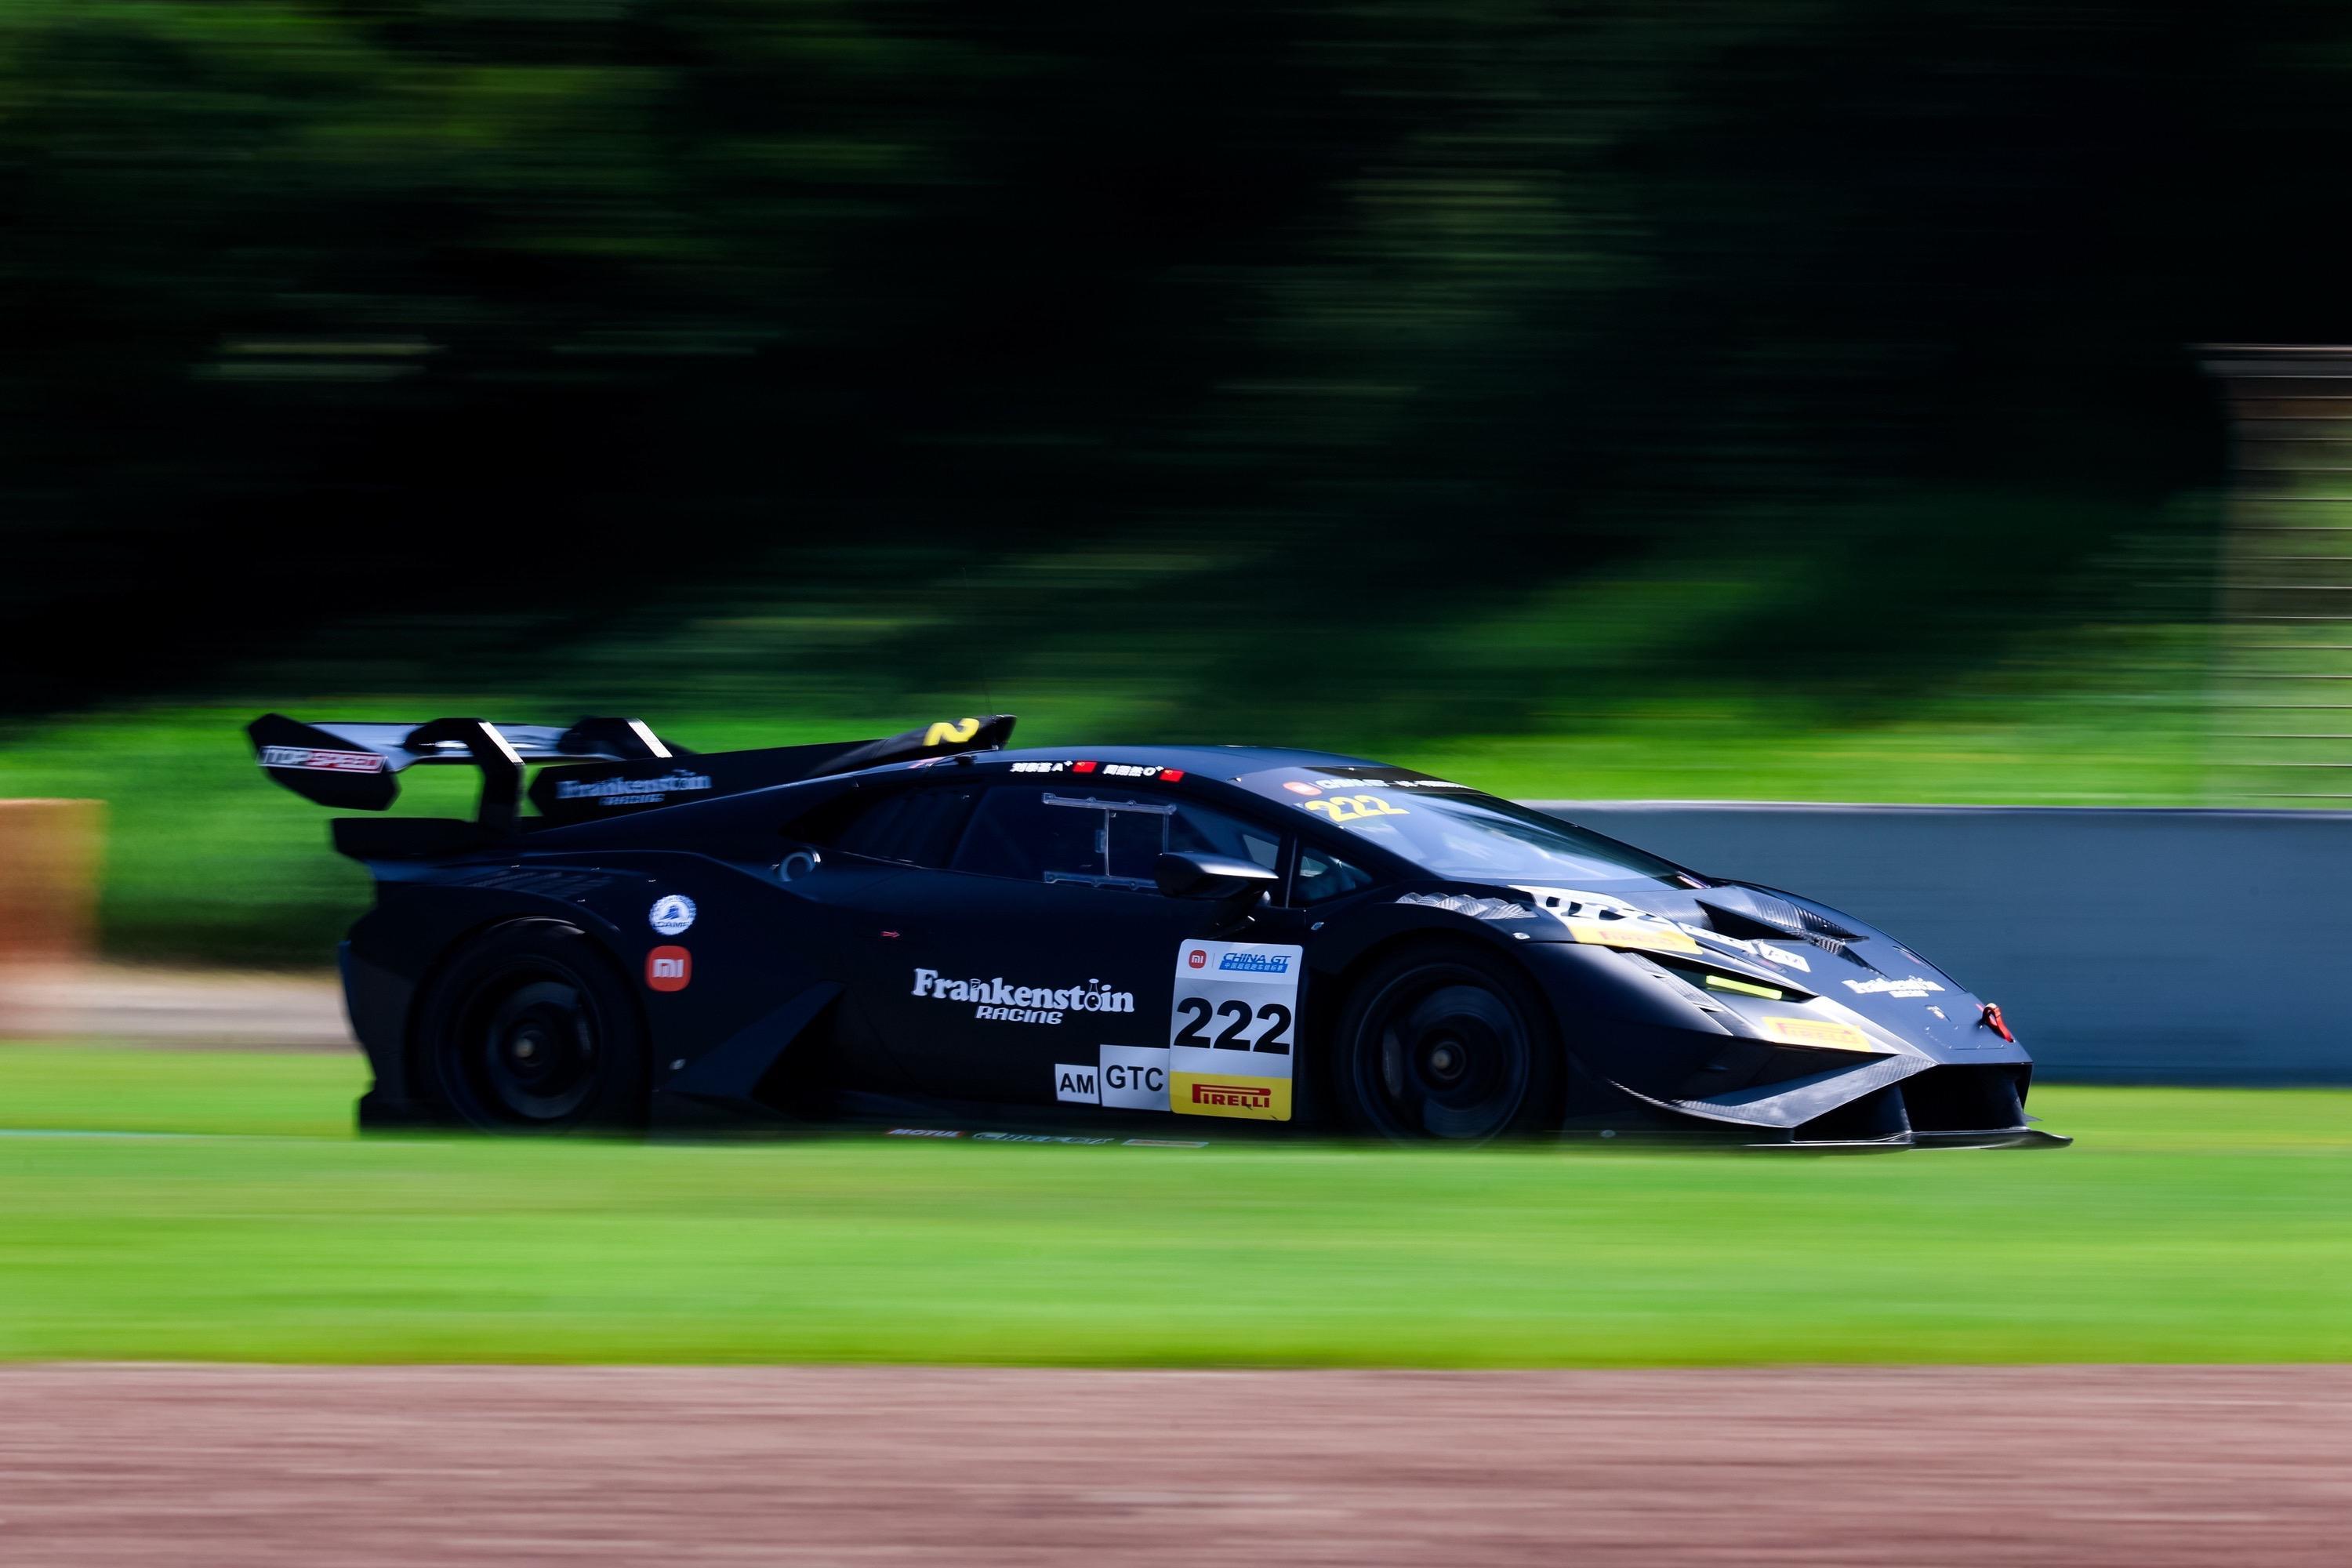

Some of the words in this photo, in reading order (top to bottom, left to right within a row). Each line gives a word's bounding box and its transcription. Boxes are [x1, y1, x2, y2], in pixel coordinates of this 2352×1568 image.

[1305, 795, 1410, 822] 222
[1223, 953, 1266, 963] CHINA
[1270, 955, 1292, 964] GT
[975, 1005, 1062, 1024] RACING
[1174, 997, 1291, 1055] 222
[1060, 1073, 1094, 1094] AM
[1105, 1065, 1163, 1092] GTC
[1192, 1083, 1271, 1108] PIRELLI
